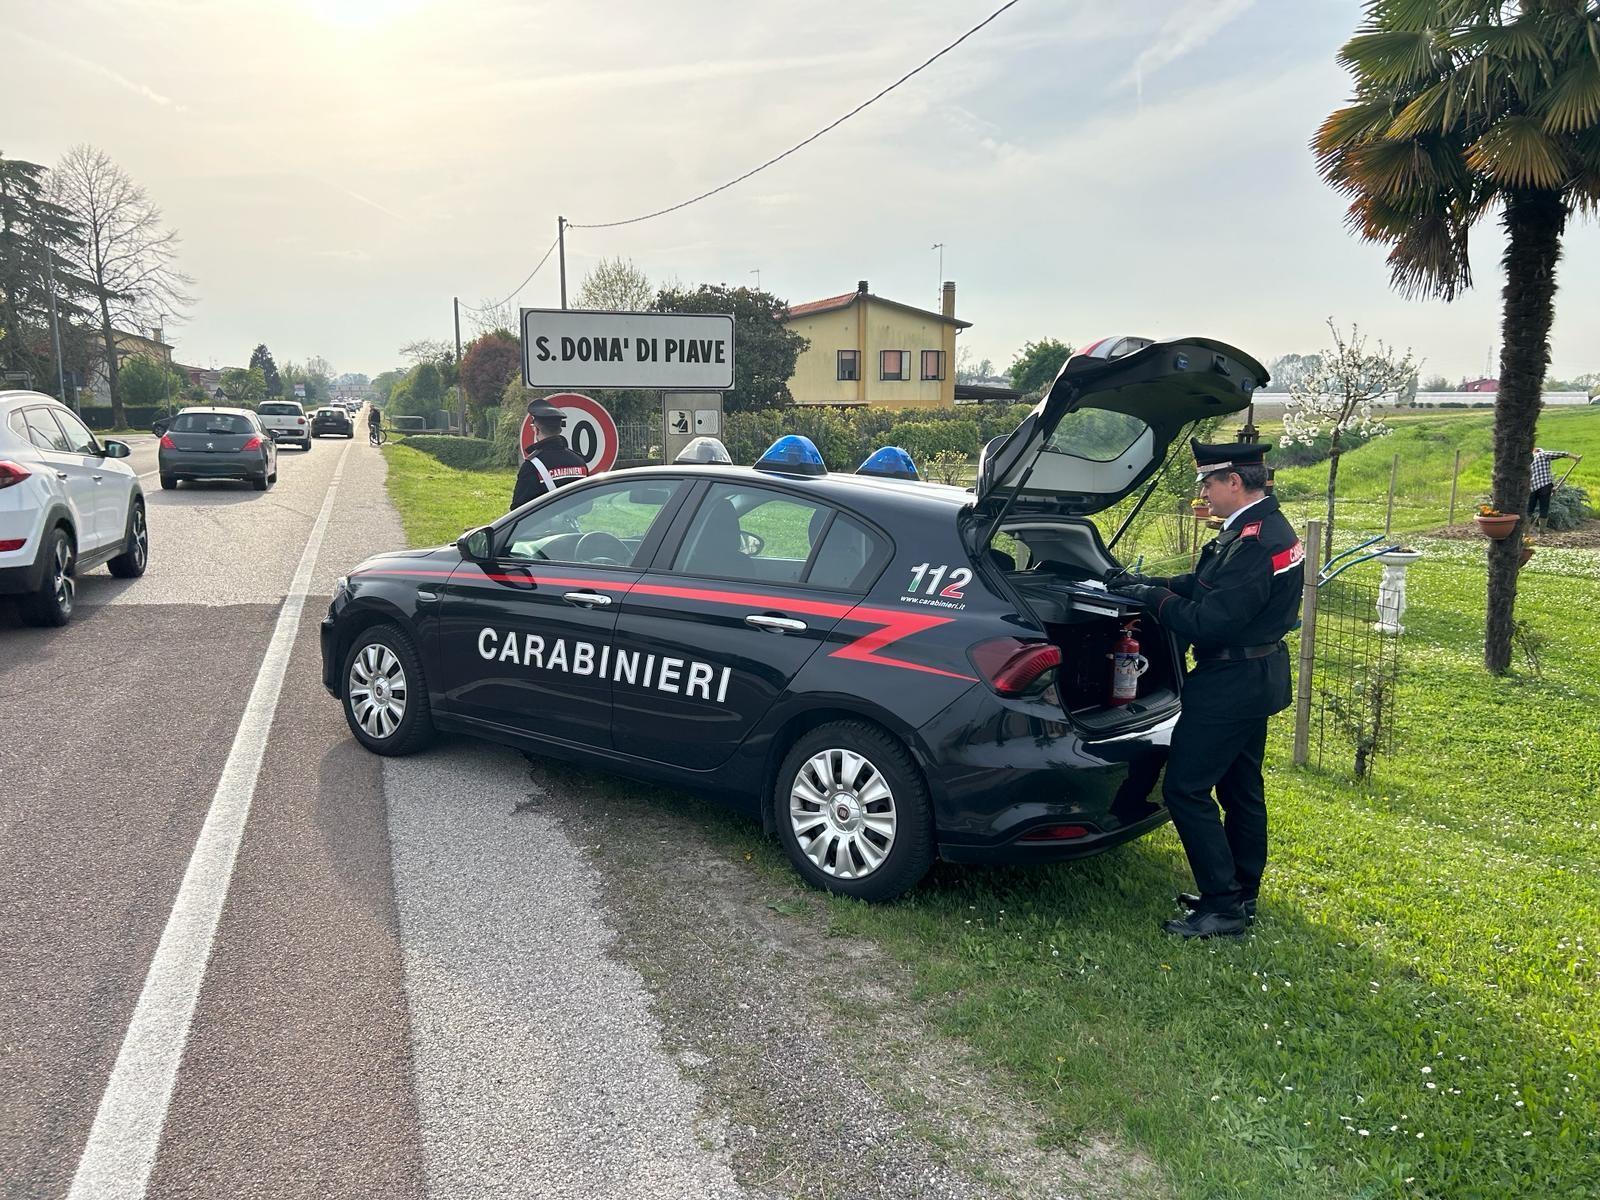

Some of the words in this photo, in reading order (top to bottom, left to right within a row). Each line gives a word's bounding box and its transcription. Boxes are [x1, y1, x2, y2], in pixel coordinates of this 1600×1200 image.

[636, 338, 657, 362] DI
[665, 339, 725, 364] PIAVE
[561, 420, 597, 464] 0
[907, 563, 973, 599] 112
[900, 596, 966, 611] www.carabinieri.it
[478, 627, 732, 703] CARABINIERI
